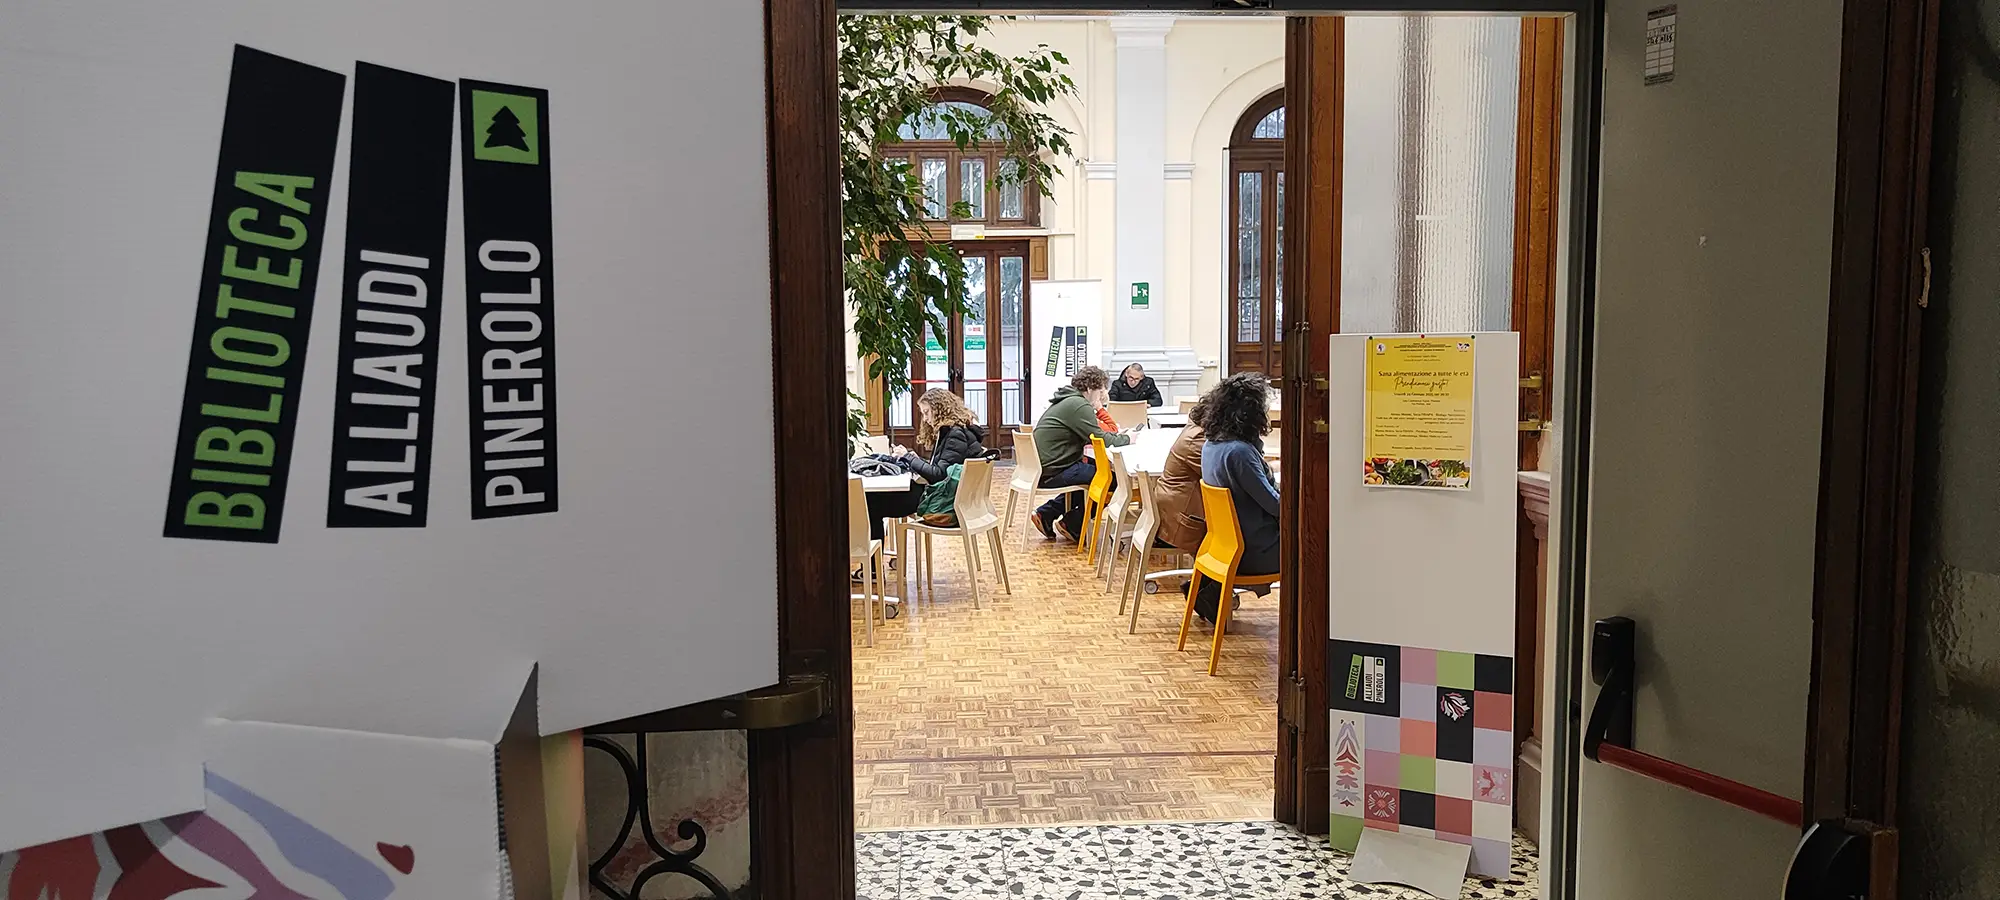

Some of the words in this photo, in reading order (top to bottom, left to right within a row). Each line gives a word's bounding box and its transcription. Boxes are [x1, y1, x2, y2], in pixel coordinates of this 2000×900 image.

[184, 170, 315, 531] BIBLIOTECA
[1046, 337, 1061, 376] BIBLIOTECA
[1066, 345, 1075, 376] ALLIAUDI
[344, 249, 430, 516] ALLIAUDI
[478, 239, 546, 508] PINEROLO
[1347, 664, 1360, 698] BIBLIOTECA
[1365, 673, 1373, 701] ALLIAUDI
[1376, 672, 1384, 702] PINEROLO
